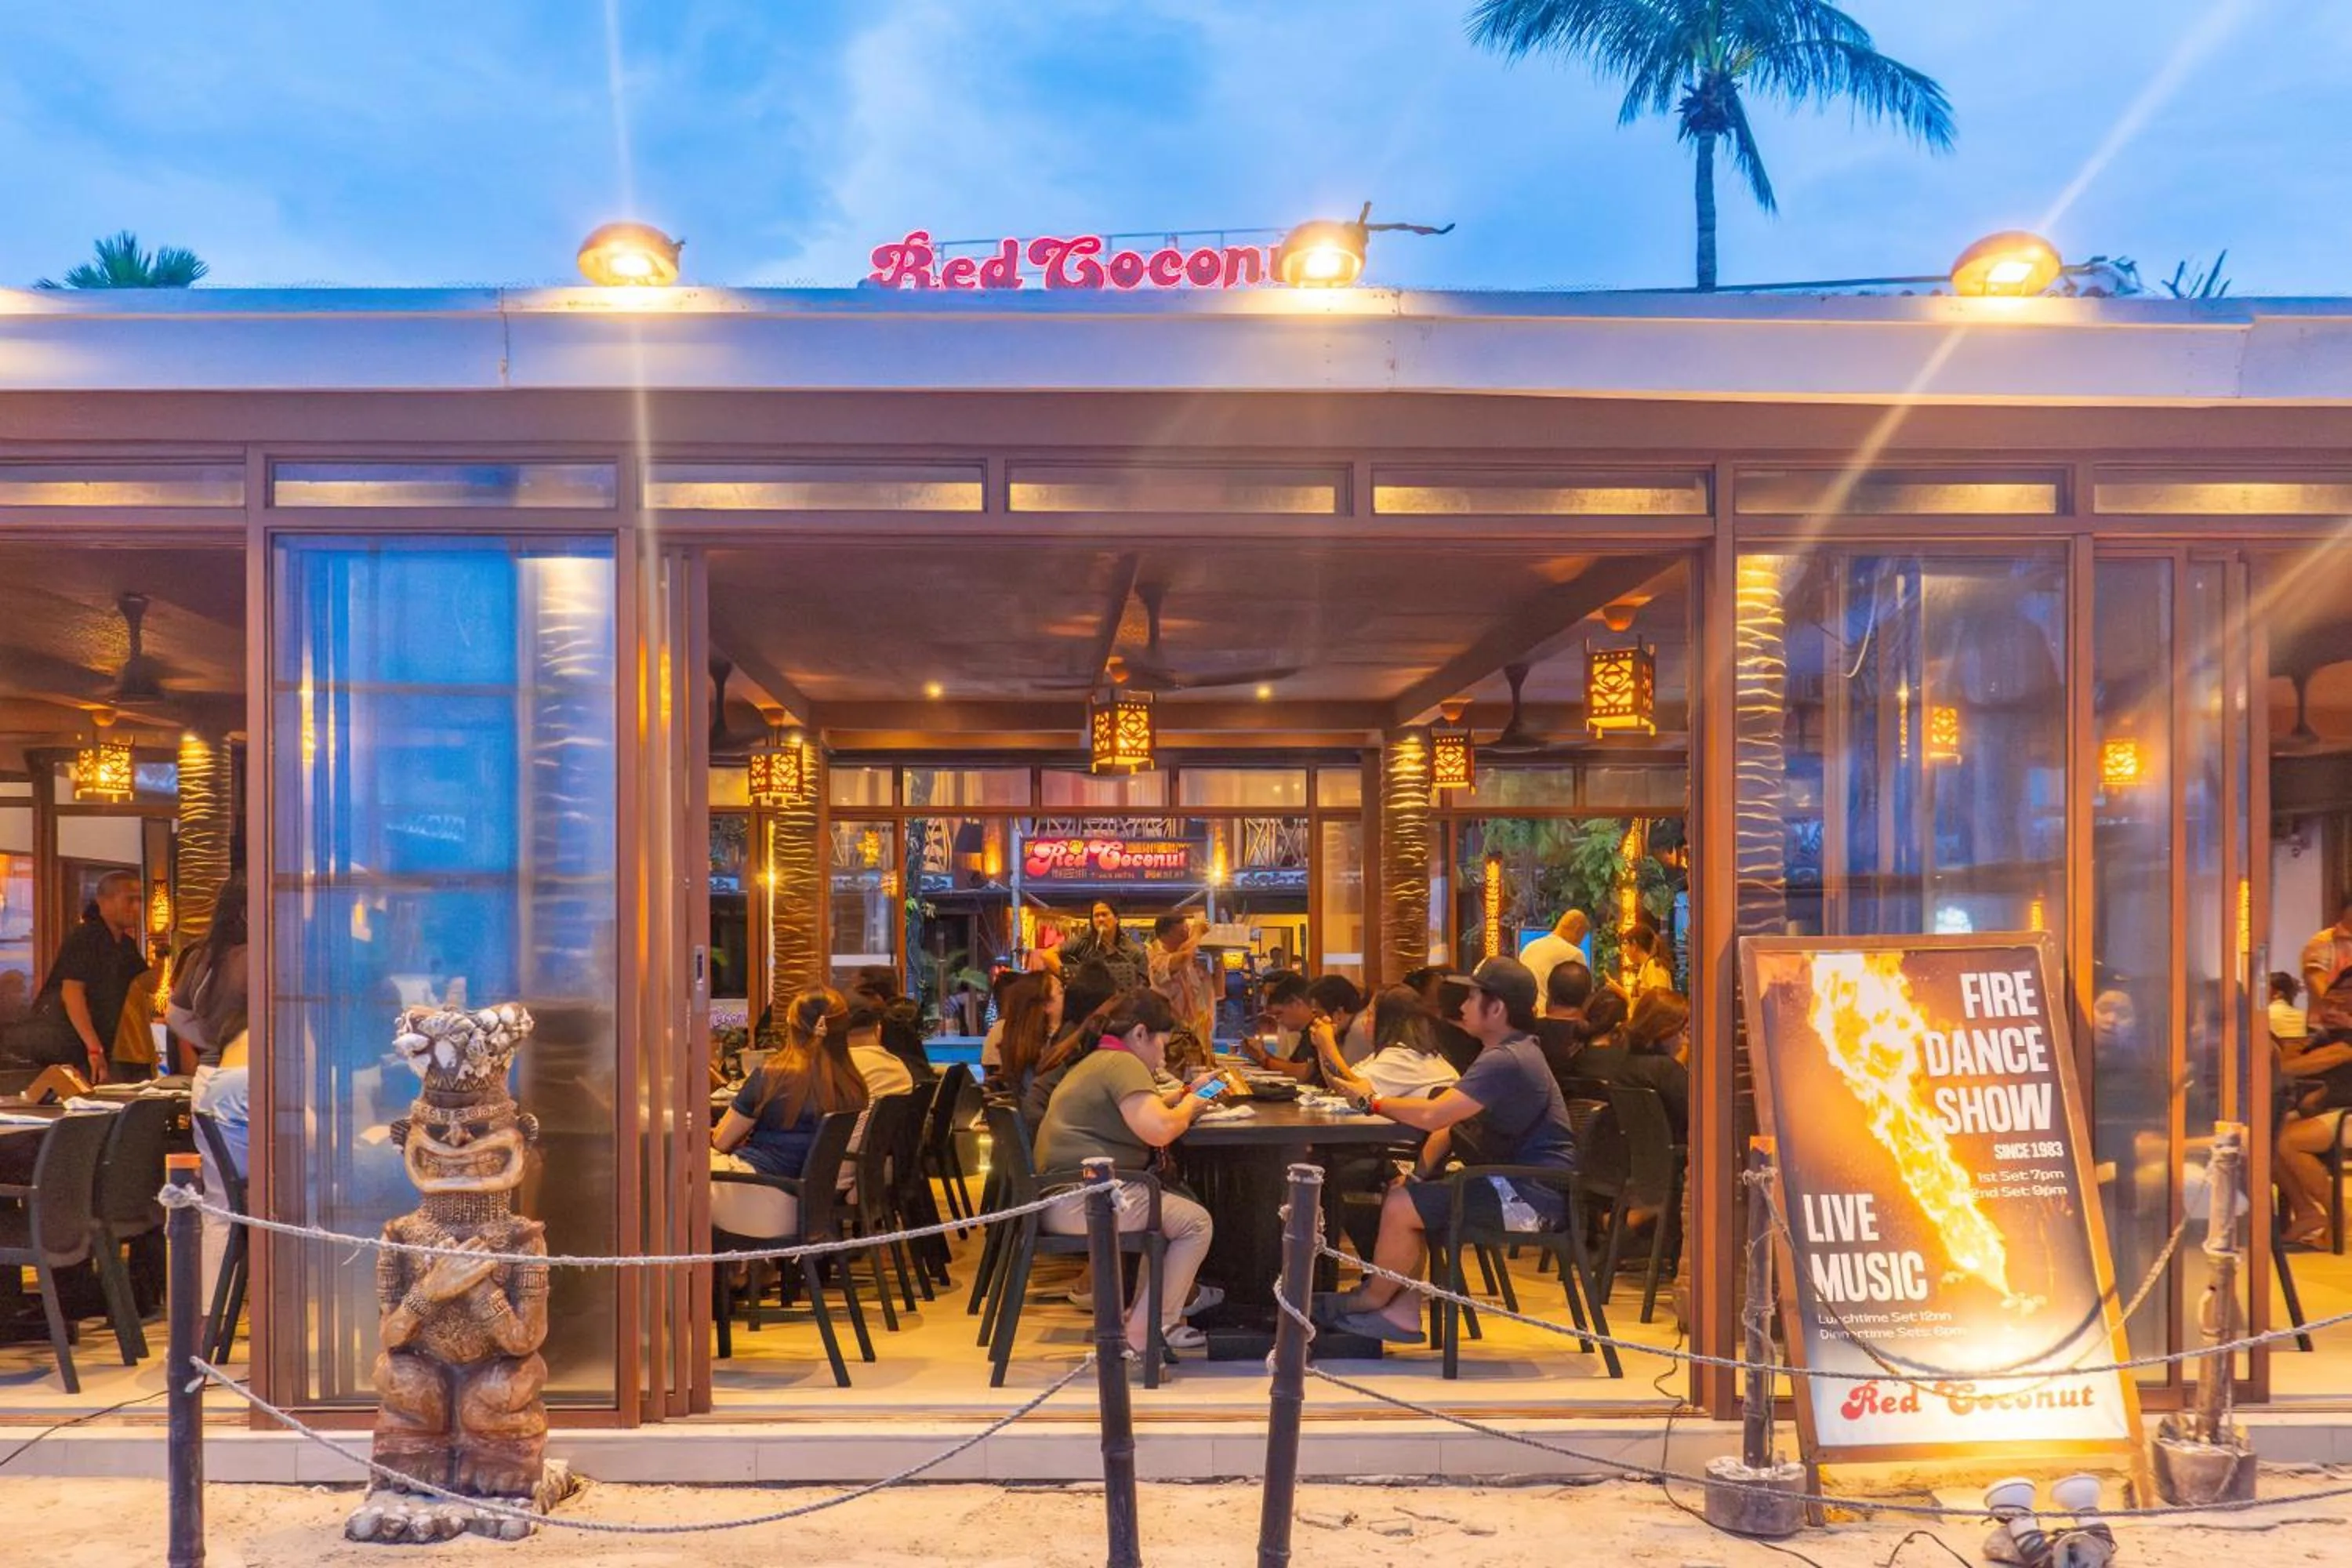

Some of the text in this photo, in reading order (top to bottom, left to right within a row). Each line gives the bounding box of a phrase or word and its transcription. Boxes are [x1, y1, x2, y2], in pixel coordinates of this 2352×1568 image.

[868, 230, 1022, 289] Red
[1025, 840, 1186, 877] Red Coconut
[1960, 971, 2039, 1018] FIRE
[1924, 1026, 2050, 1076] DANCE
[1934, 1083, 2053, 1134] SHOW
[1994, 1142, 2064, 1160] SINCE 1983
[1976, 1171, 1998, 1182] 1st
[2030, 1169, 2065, 1181] 7pm
[1803, 1193, 1880, 1243] LIVE
[1810, 1250, 1929, 1303] MUSIC
[1840, 1378, 1922, 1421] Red
